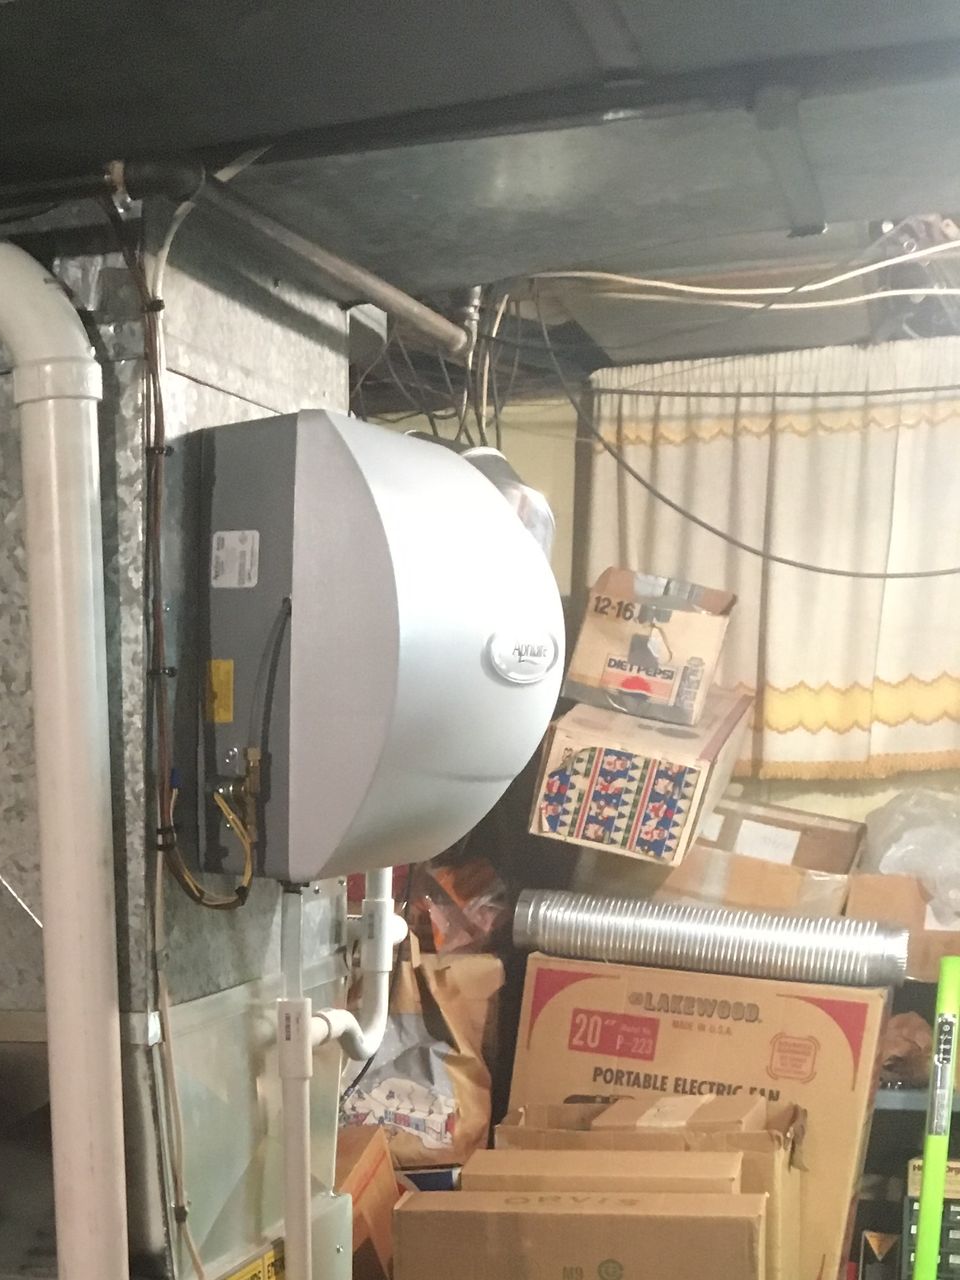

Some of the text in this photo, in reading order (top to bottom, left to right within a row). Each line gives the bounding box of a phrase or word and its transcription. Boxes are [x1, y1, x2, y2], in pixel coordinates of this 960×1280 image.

[594, 596, 636, 621] 12-16
[607, 658, 675, 681] DIET PEPSI
[643, 991, 760, 1023] LAKEWOOD
[592, 1066, 669, 1093] PORTABLE
[673, 1076, 743, 1098] ELECTRIC
